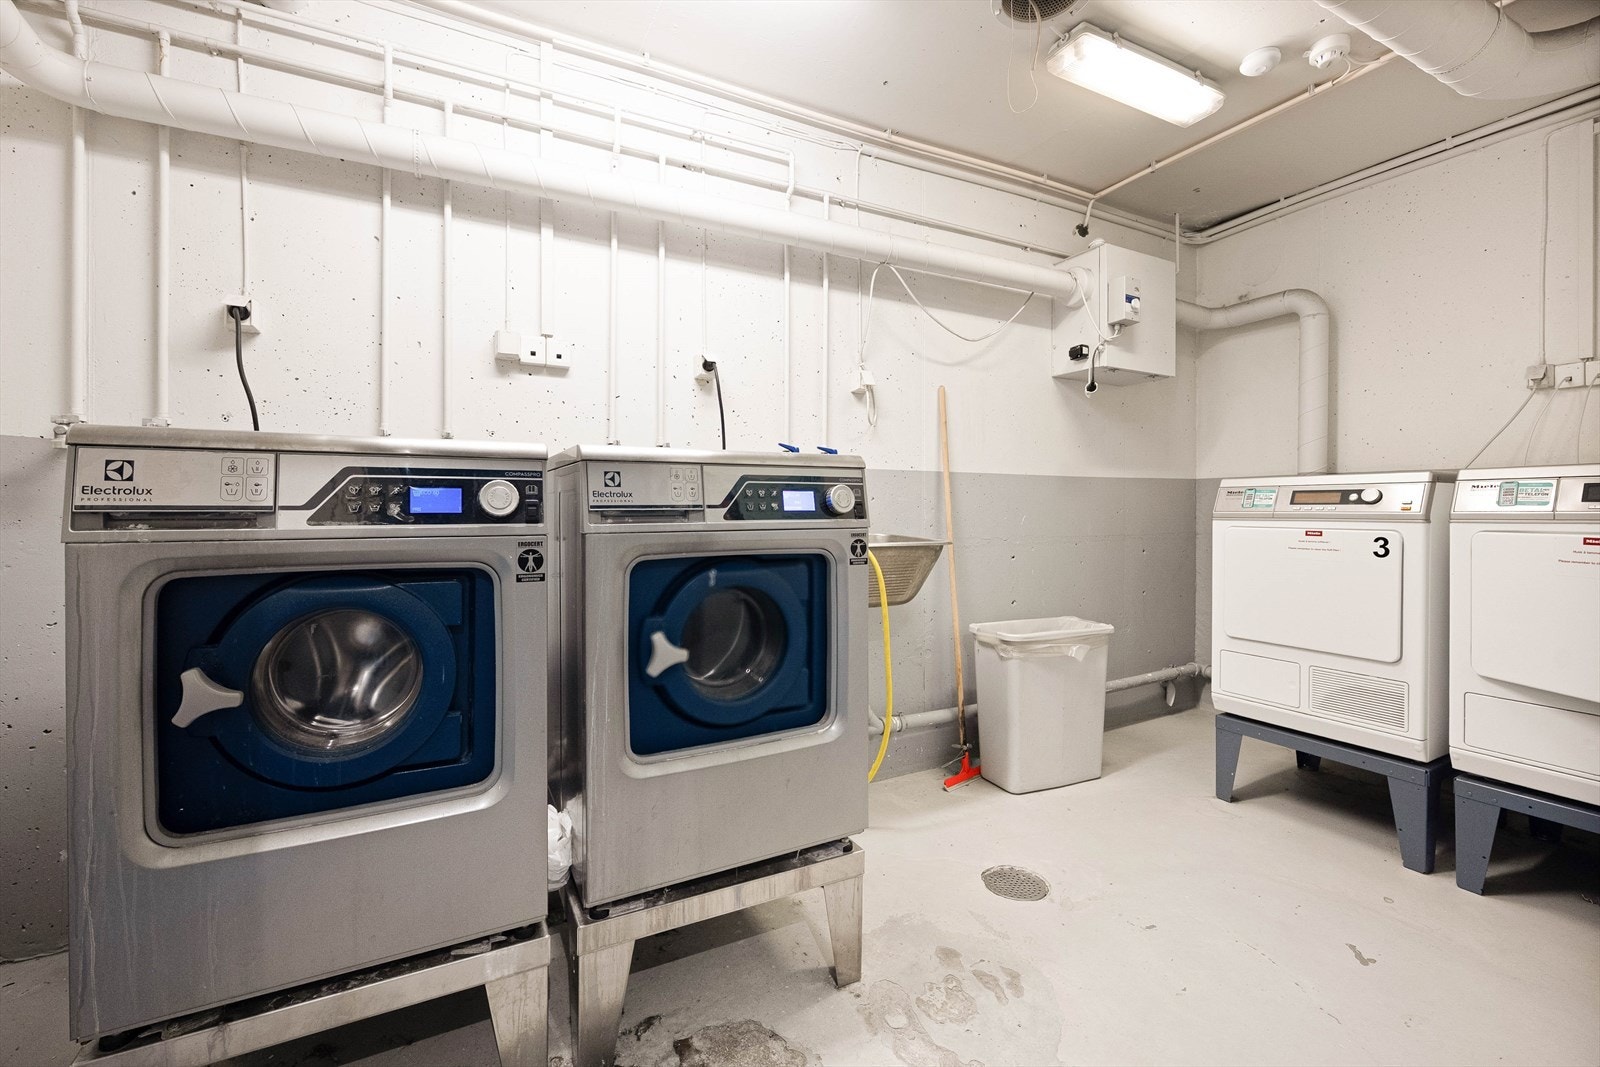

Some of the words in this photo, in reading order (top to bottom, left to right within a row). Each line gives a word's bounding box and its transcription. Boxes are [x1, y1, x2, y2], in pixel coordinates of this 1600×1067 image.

[81, 485, 153, 496] Electrolux
[592, 490, 633, 498] Electrolux
[1372, 536, 1390, 558] 3
